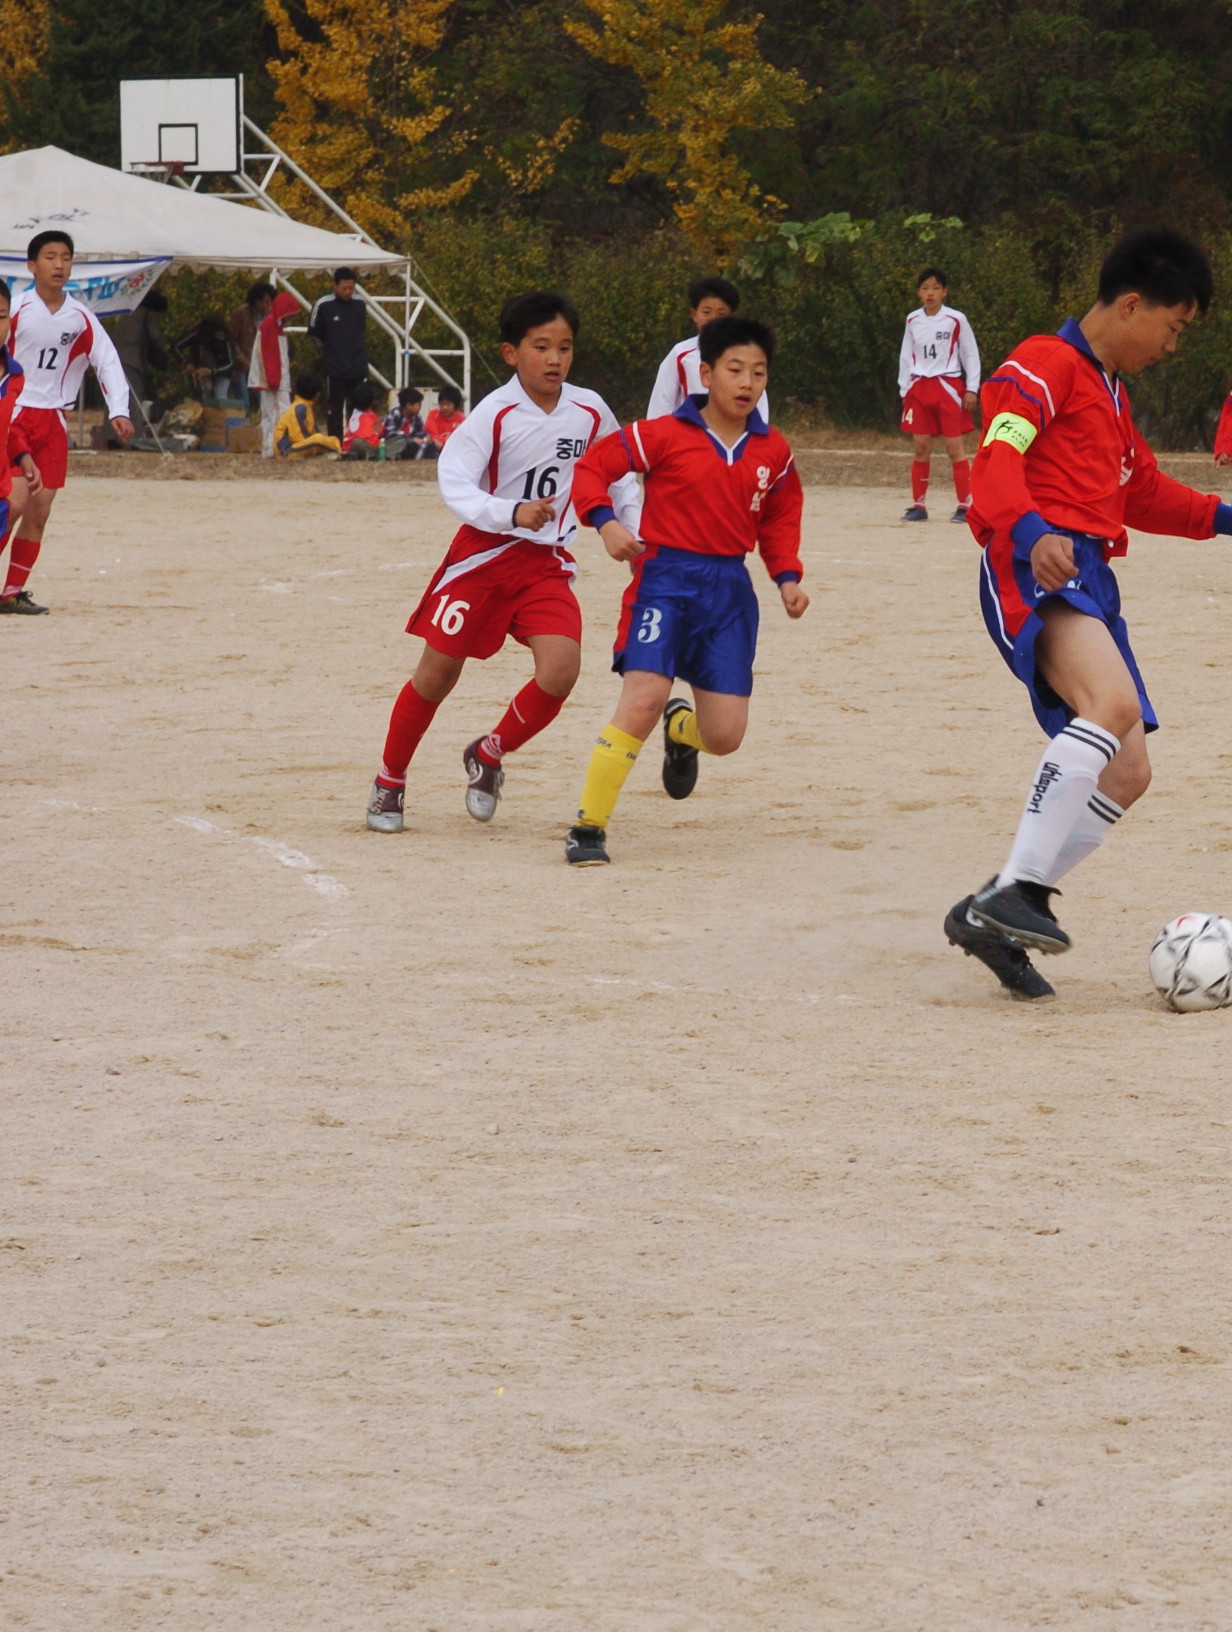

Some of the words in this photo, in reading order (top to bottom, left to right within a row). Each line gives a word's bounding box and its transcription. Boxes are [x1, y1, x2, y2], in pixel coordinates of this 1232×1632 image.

[37, 347, 58, 370] 12
[923, 344, 937, 360] 14
[521, 465, 560, 500] 16
[431, 593, 471, 636] 16
[637, 607, 662, 644] 3
[1027, 761, 1063, 814] uhlsport
